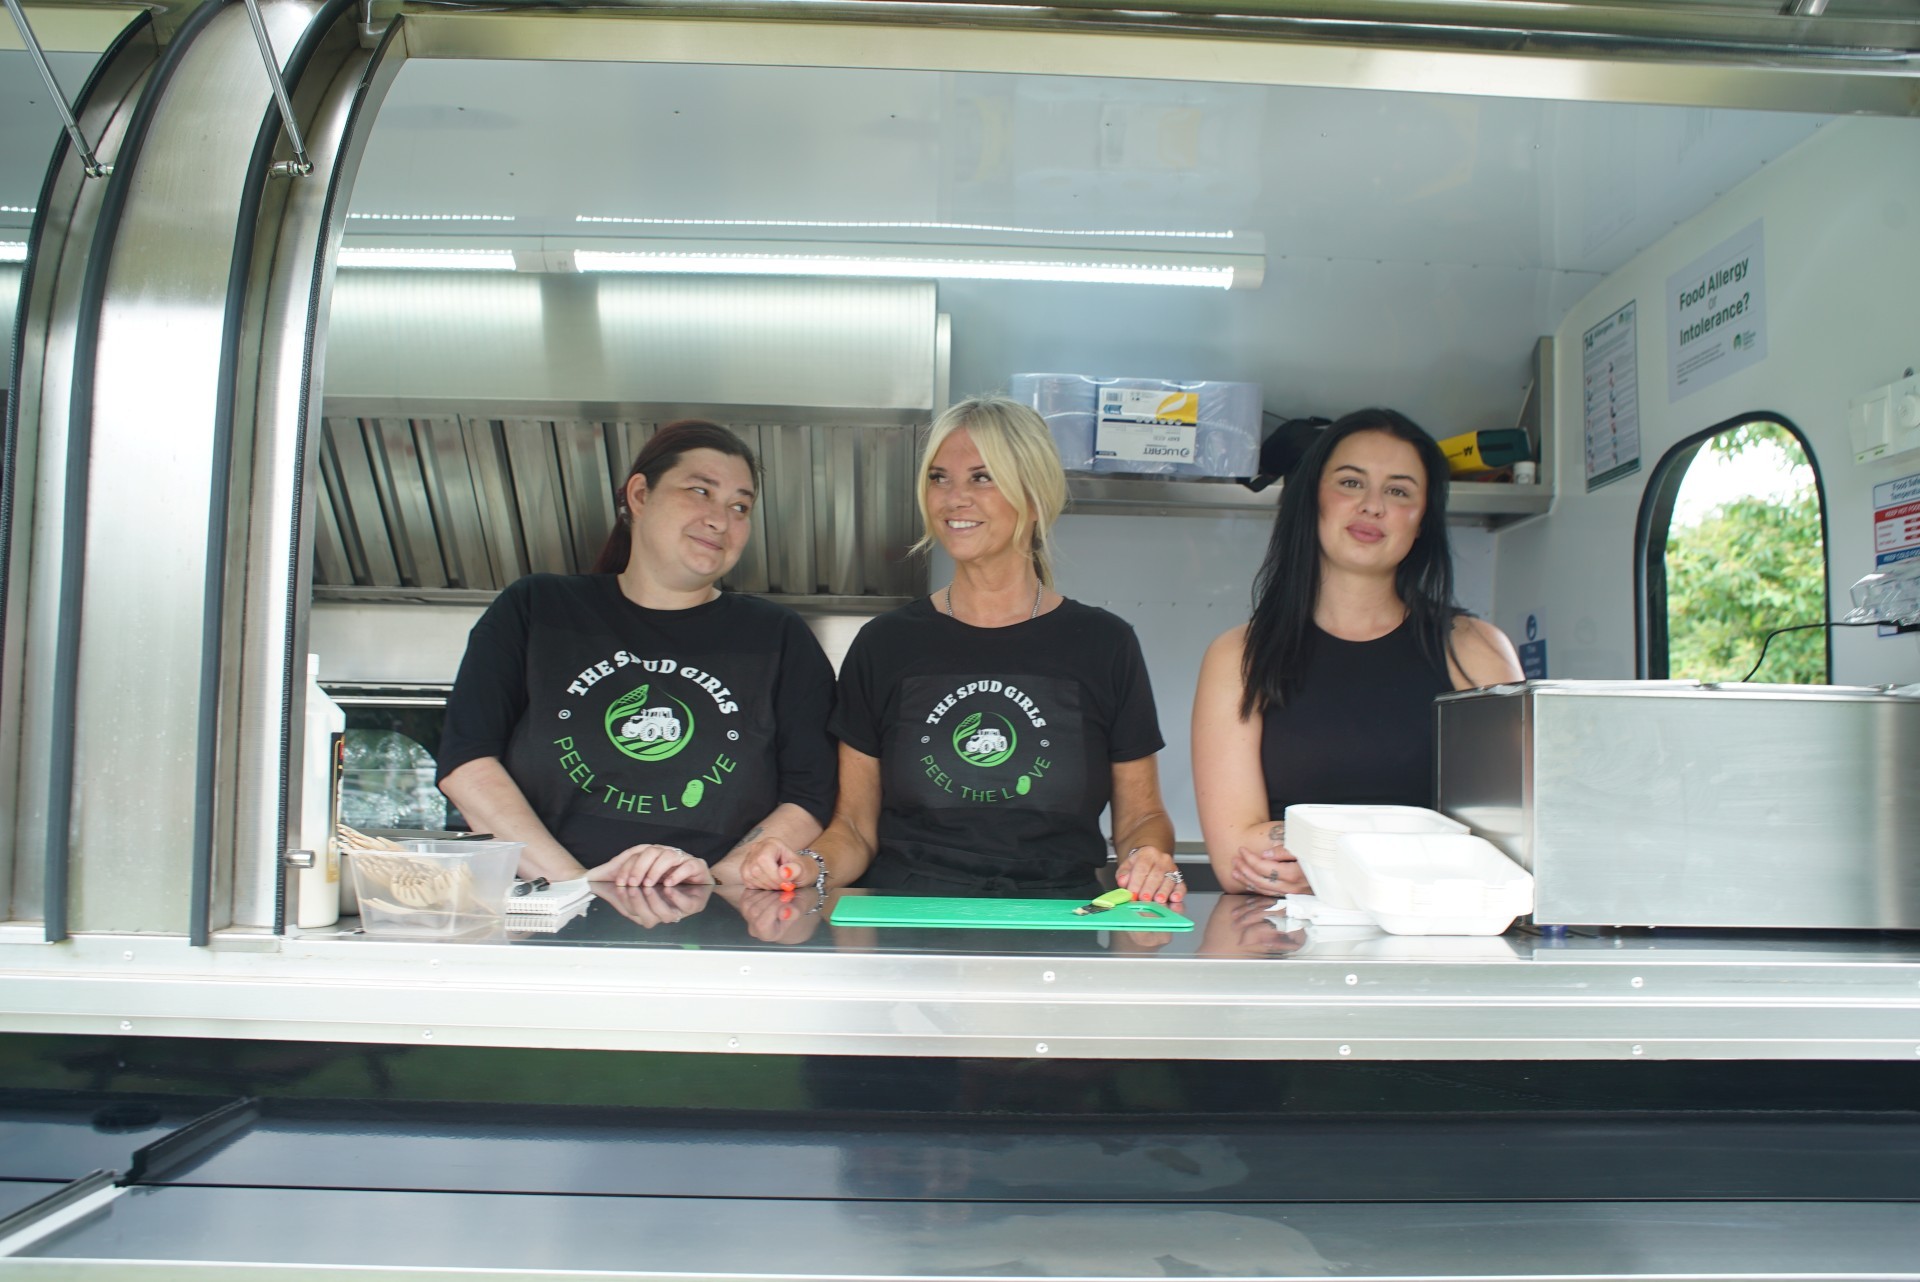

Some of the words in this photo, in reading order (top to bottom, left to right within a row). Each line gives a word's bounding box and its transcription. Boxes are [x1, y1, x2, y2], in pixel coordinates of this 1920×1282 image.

[1679, 280, 1705, 311] Food
[1707, 257, 1749, 295] Allergy
[1679, 291, 1750, 346] Intolerance?
[1143, 447, 1180, 456] LUCART
[566, 660, 615, 696] THE
[679, 666, 739, 714] GIRLS
[926, 693, 957, 725] THE
[956, 680, 1002, 699] SPUD
[1004, 686, 1047, 728] GIRLS
[553, 736, 595, 793] PEEL
[603, 784, 654, 813] THE
[920, 755, 953, 793] PEEL
[961, 786, 998, 802] THE
